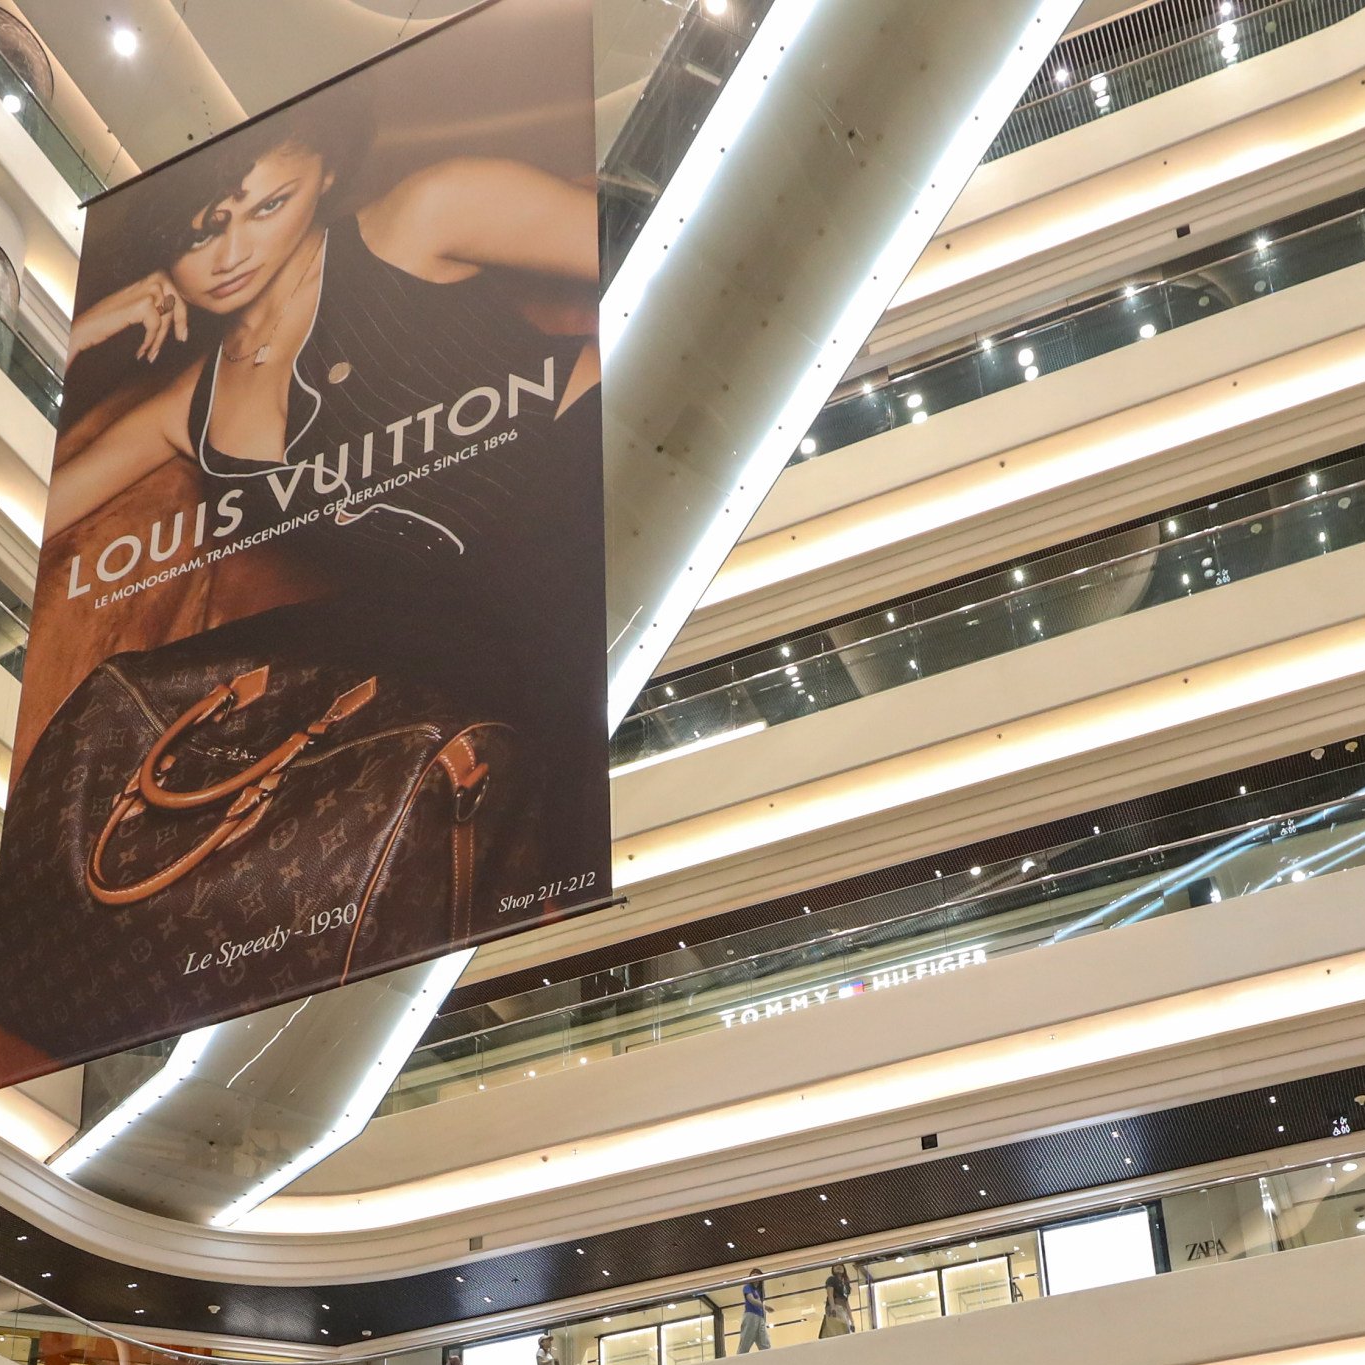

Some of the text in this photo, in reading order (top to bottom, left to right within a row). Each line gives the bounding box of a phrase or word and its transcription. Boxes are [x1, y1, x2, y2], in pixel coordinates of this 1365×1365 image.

[66, 357, 556, 599] LOUIS VUITTON
[94, 429, 519, 609] LE MONOGRAM, TRANSCENDING GENERATIONS SINCE 1896
[498, 871, 596, 915] Shop 211-212
[183, 946, 211, 977] Le
[215, 925, 291, 966] Speedy
[306, 902, 358, 937] 1930
[720, 989, 829, 1029] TOMMY
